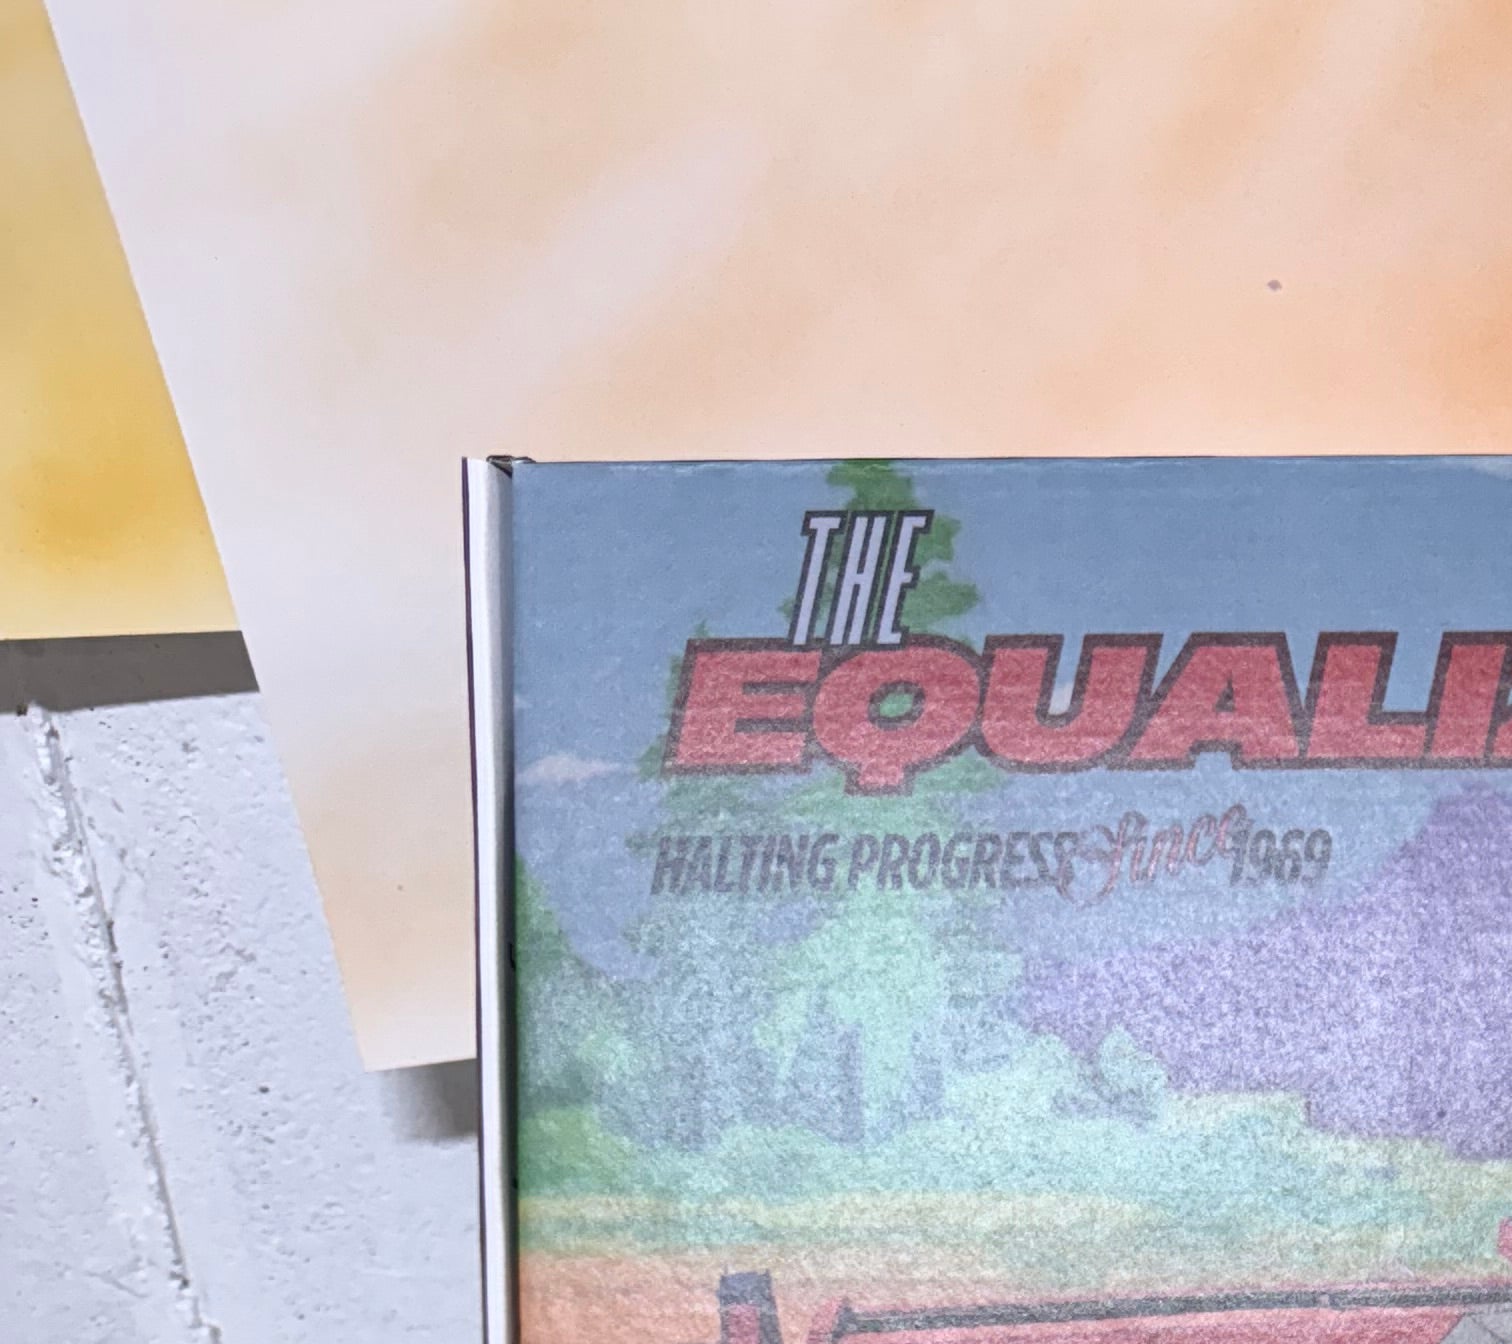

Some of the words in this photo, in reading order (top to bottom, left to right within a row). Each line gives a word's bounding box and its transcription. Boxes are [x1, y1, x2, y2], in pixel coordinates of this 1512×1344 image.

[790, 509, 933, 645] THE
[651, 831, 838, 894] HALTING
[1229, 828, 1333, 888] 1969
